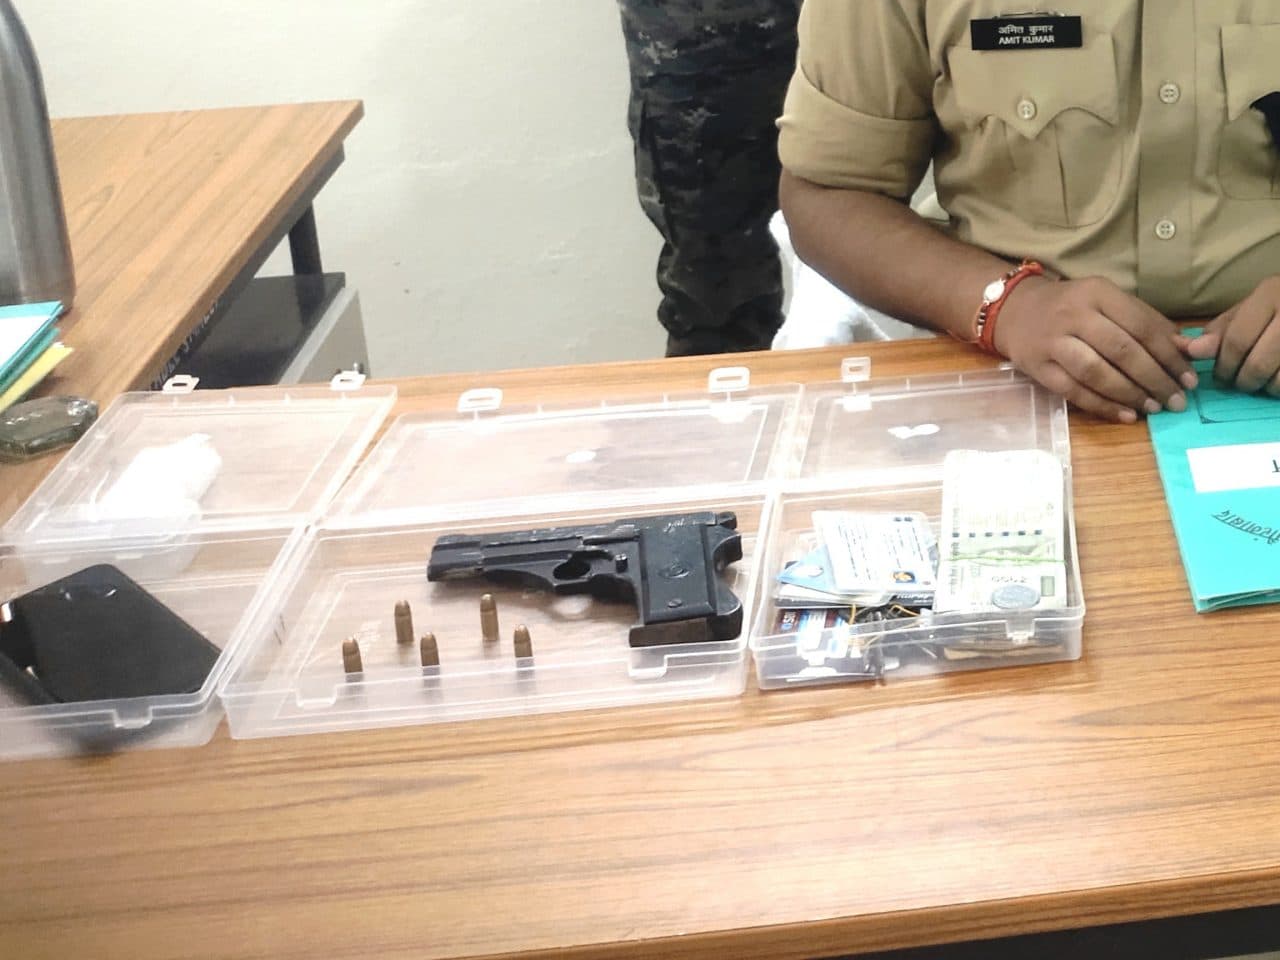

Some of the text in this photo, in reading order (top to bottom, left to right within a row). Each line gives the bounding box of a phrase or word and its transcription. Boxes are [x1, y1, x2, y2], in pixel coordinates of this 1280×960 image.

[998, 24, 1054, 35] अमित कुमार
[999, 35, 1055, 45] AMIT KUMAR
